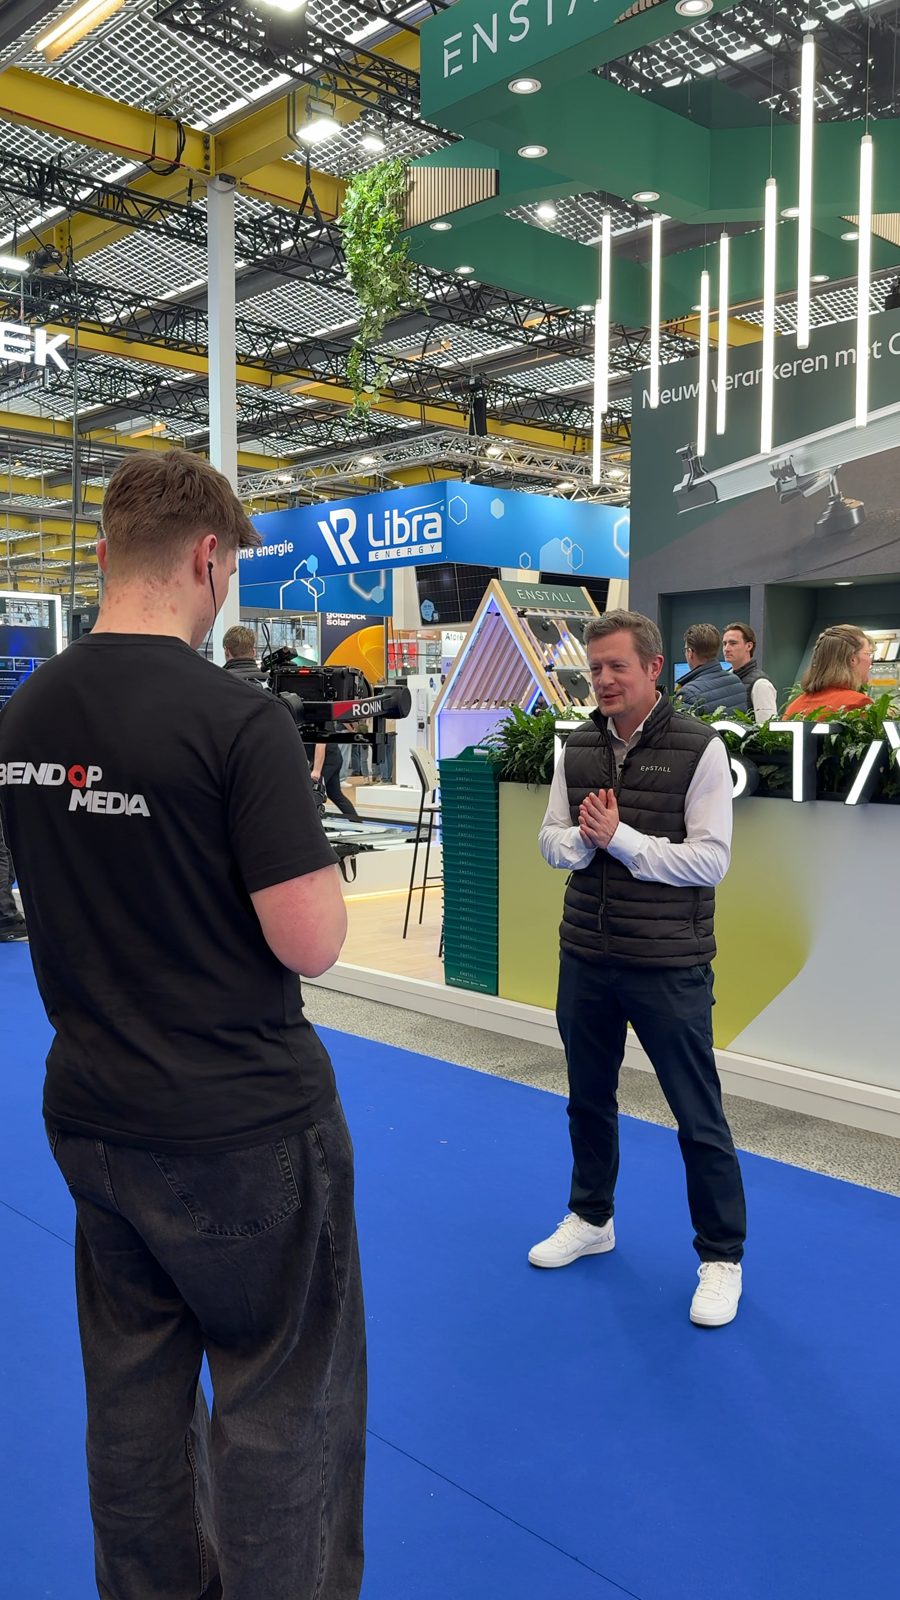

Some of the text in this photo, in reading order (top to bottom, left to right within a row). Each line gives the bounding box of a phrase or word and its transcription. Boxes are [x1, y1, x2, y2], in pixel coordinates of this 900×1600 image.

[443, 0, 599, 78] ENS
[642, 382, 700, 409] Neuw
[835, 340, 882, 367] mt
[367, 505, 443, 548] Libra
[256, 539, 294, 557] energie
[374, 544, 437, 560] ENERGY
[516, 589, 576, 603] ENSTALL
[326, 618, 350, 627] solar
[352, 700, 382, 716] RONIN
[640, 765, 671, 773] ENSTALL
[68, 788, 151, 817] MEDIA
